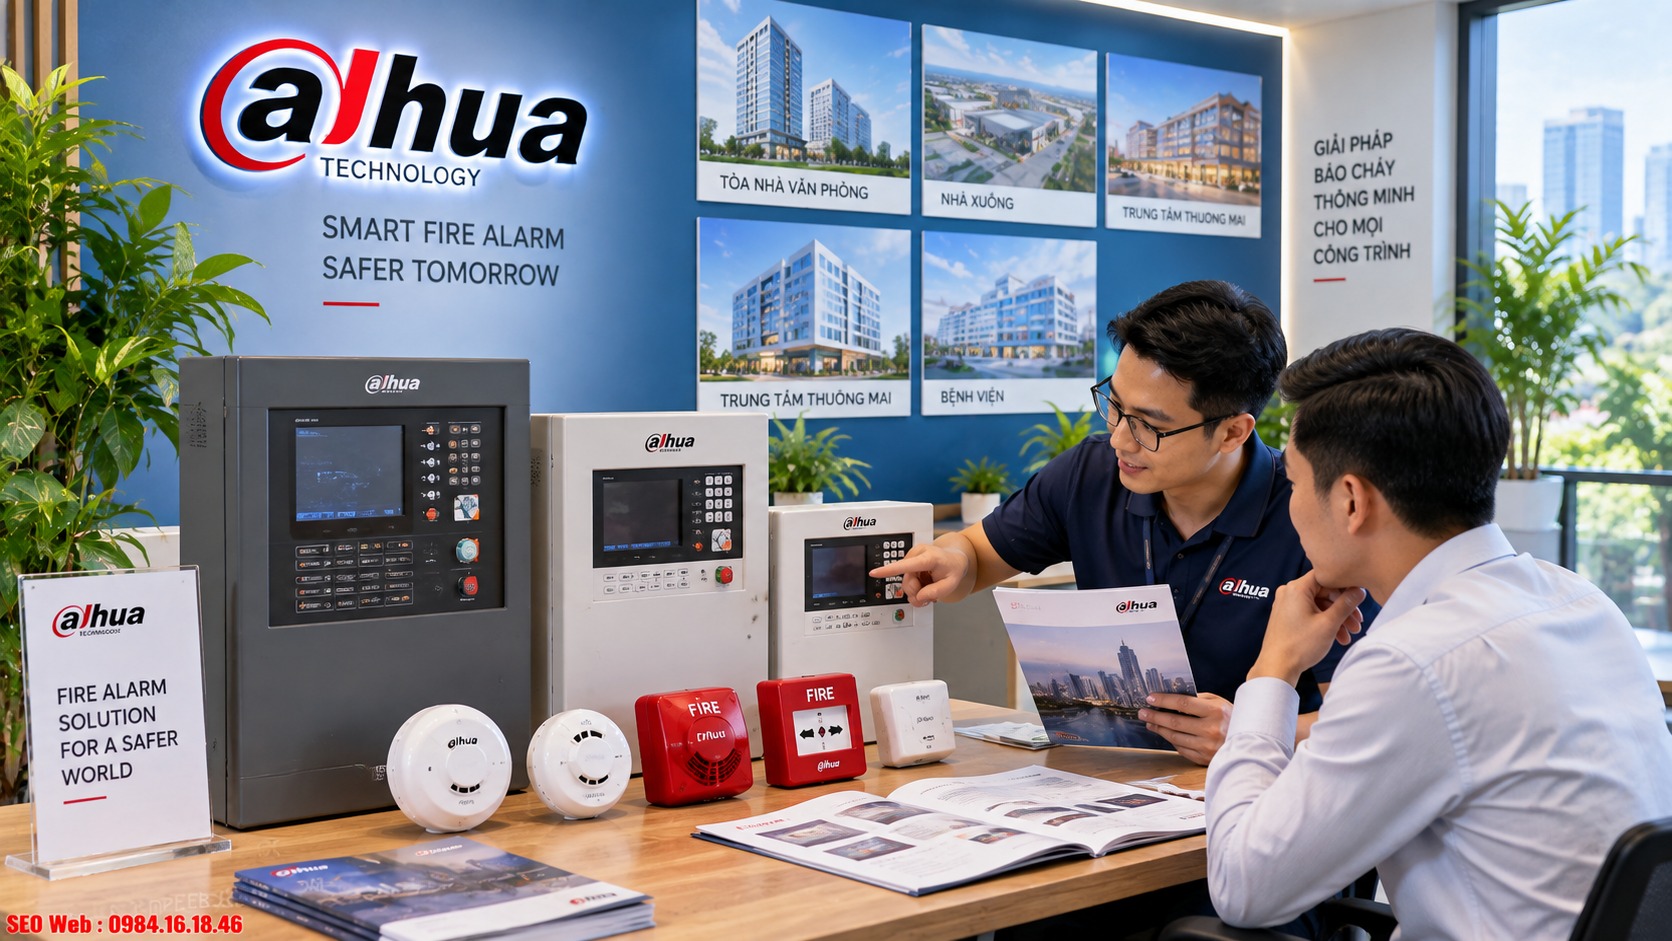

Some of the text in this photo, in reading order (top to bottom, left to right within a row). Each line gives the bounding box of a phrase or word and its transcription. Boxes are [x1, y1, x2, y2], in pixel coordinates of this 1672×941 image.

[319, 156, 481, 187] TECHNOLOGY
[1373, 185, 1415, 205] MINH
[1122, 206, 1158, 220] TRUNG
[322, 215, 565, 250] SMART FIRE ALARM
[1313, 219, 1348, 238] CHO
[322, 256, 560, 287] SAFER TOMORROW
[720, 393, 771, 408] TRUNG
[868, 392, 892, 405] MAI
[57, 678, 167, 705] FIRE ALARM
[806, 686, 834, 702] FIRE
[58, 705, 157, 732] SOLUTION
[688, 700, 721, 717] FIRE
[60, 729, 179, 760] FOR A SAFER
[61, 761, 133, 787] WORLD
